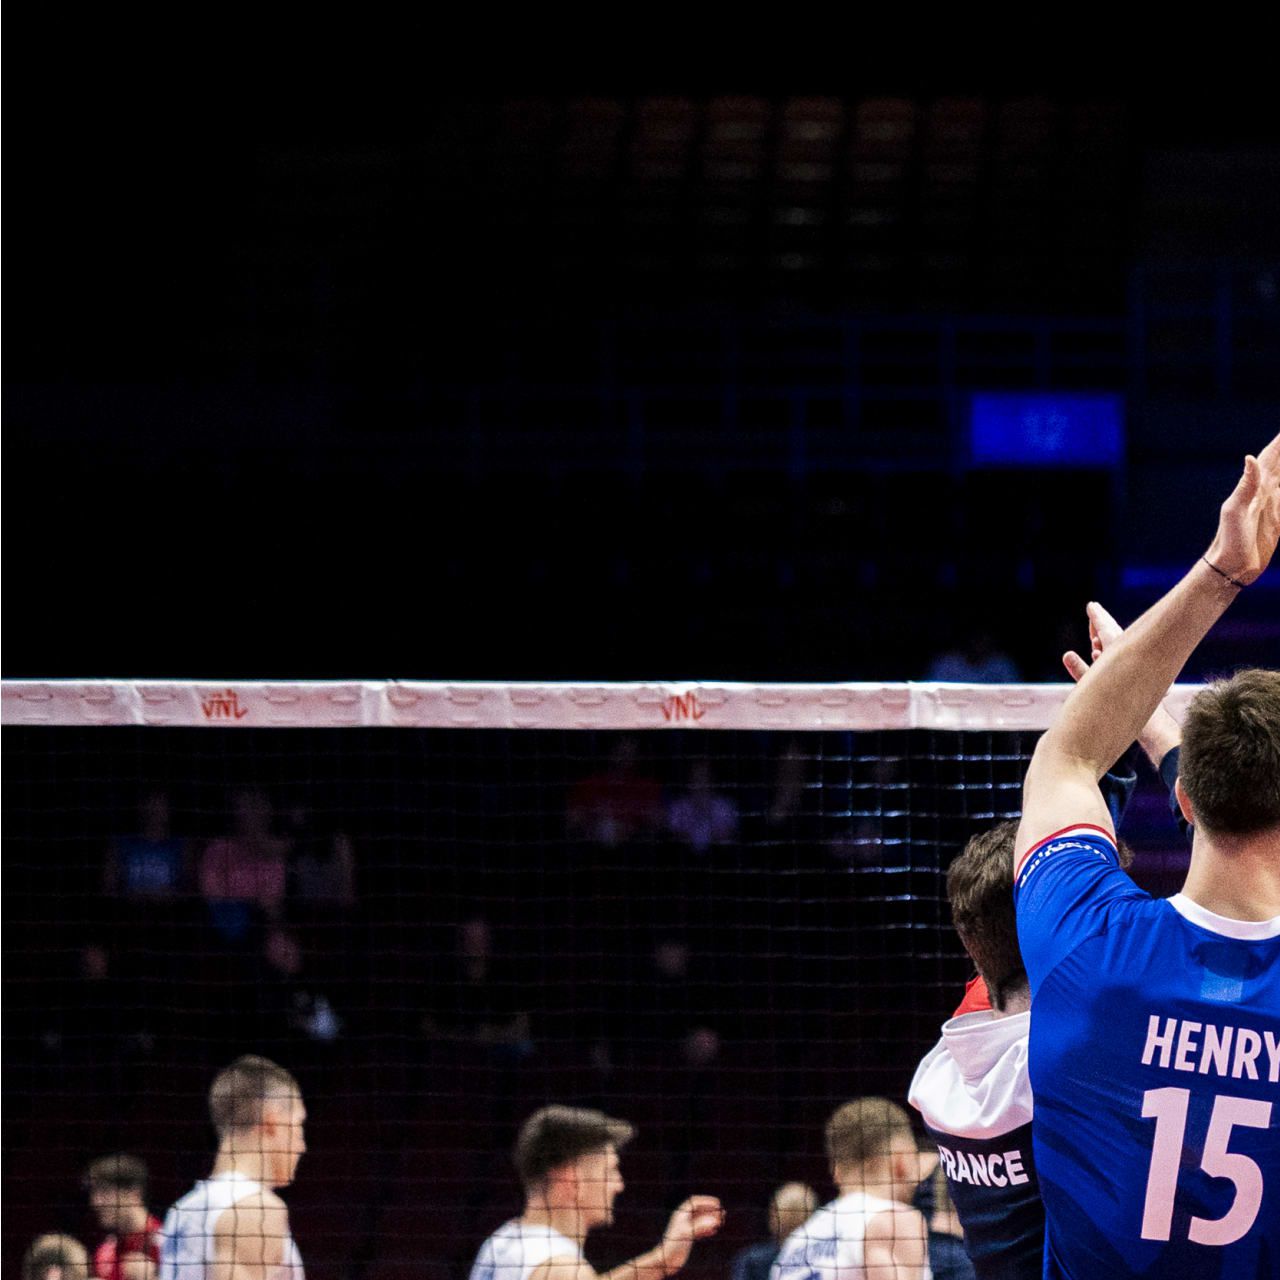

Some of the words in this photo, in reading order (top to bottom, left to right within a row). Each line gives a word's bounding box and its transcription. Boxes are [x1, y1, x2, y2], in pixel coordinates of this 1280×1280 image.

[660, 690, 705, 721] VNL
[937, 1144, 1030, 1188] FRANCE
[1140, 1086, 1273, 1247] 15
